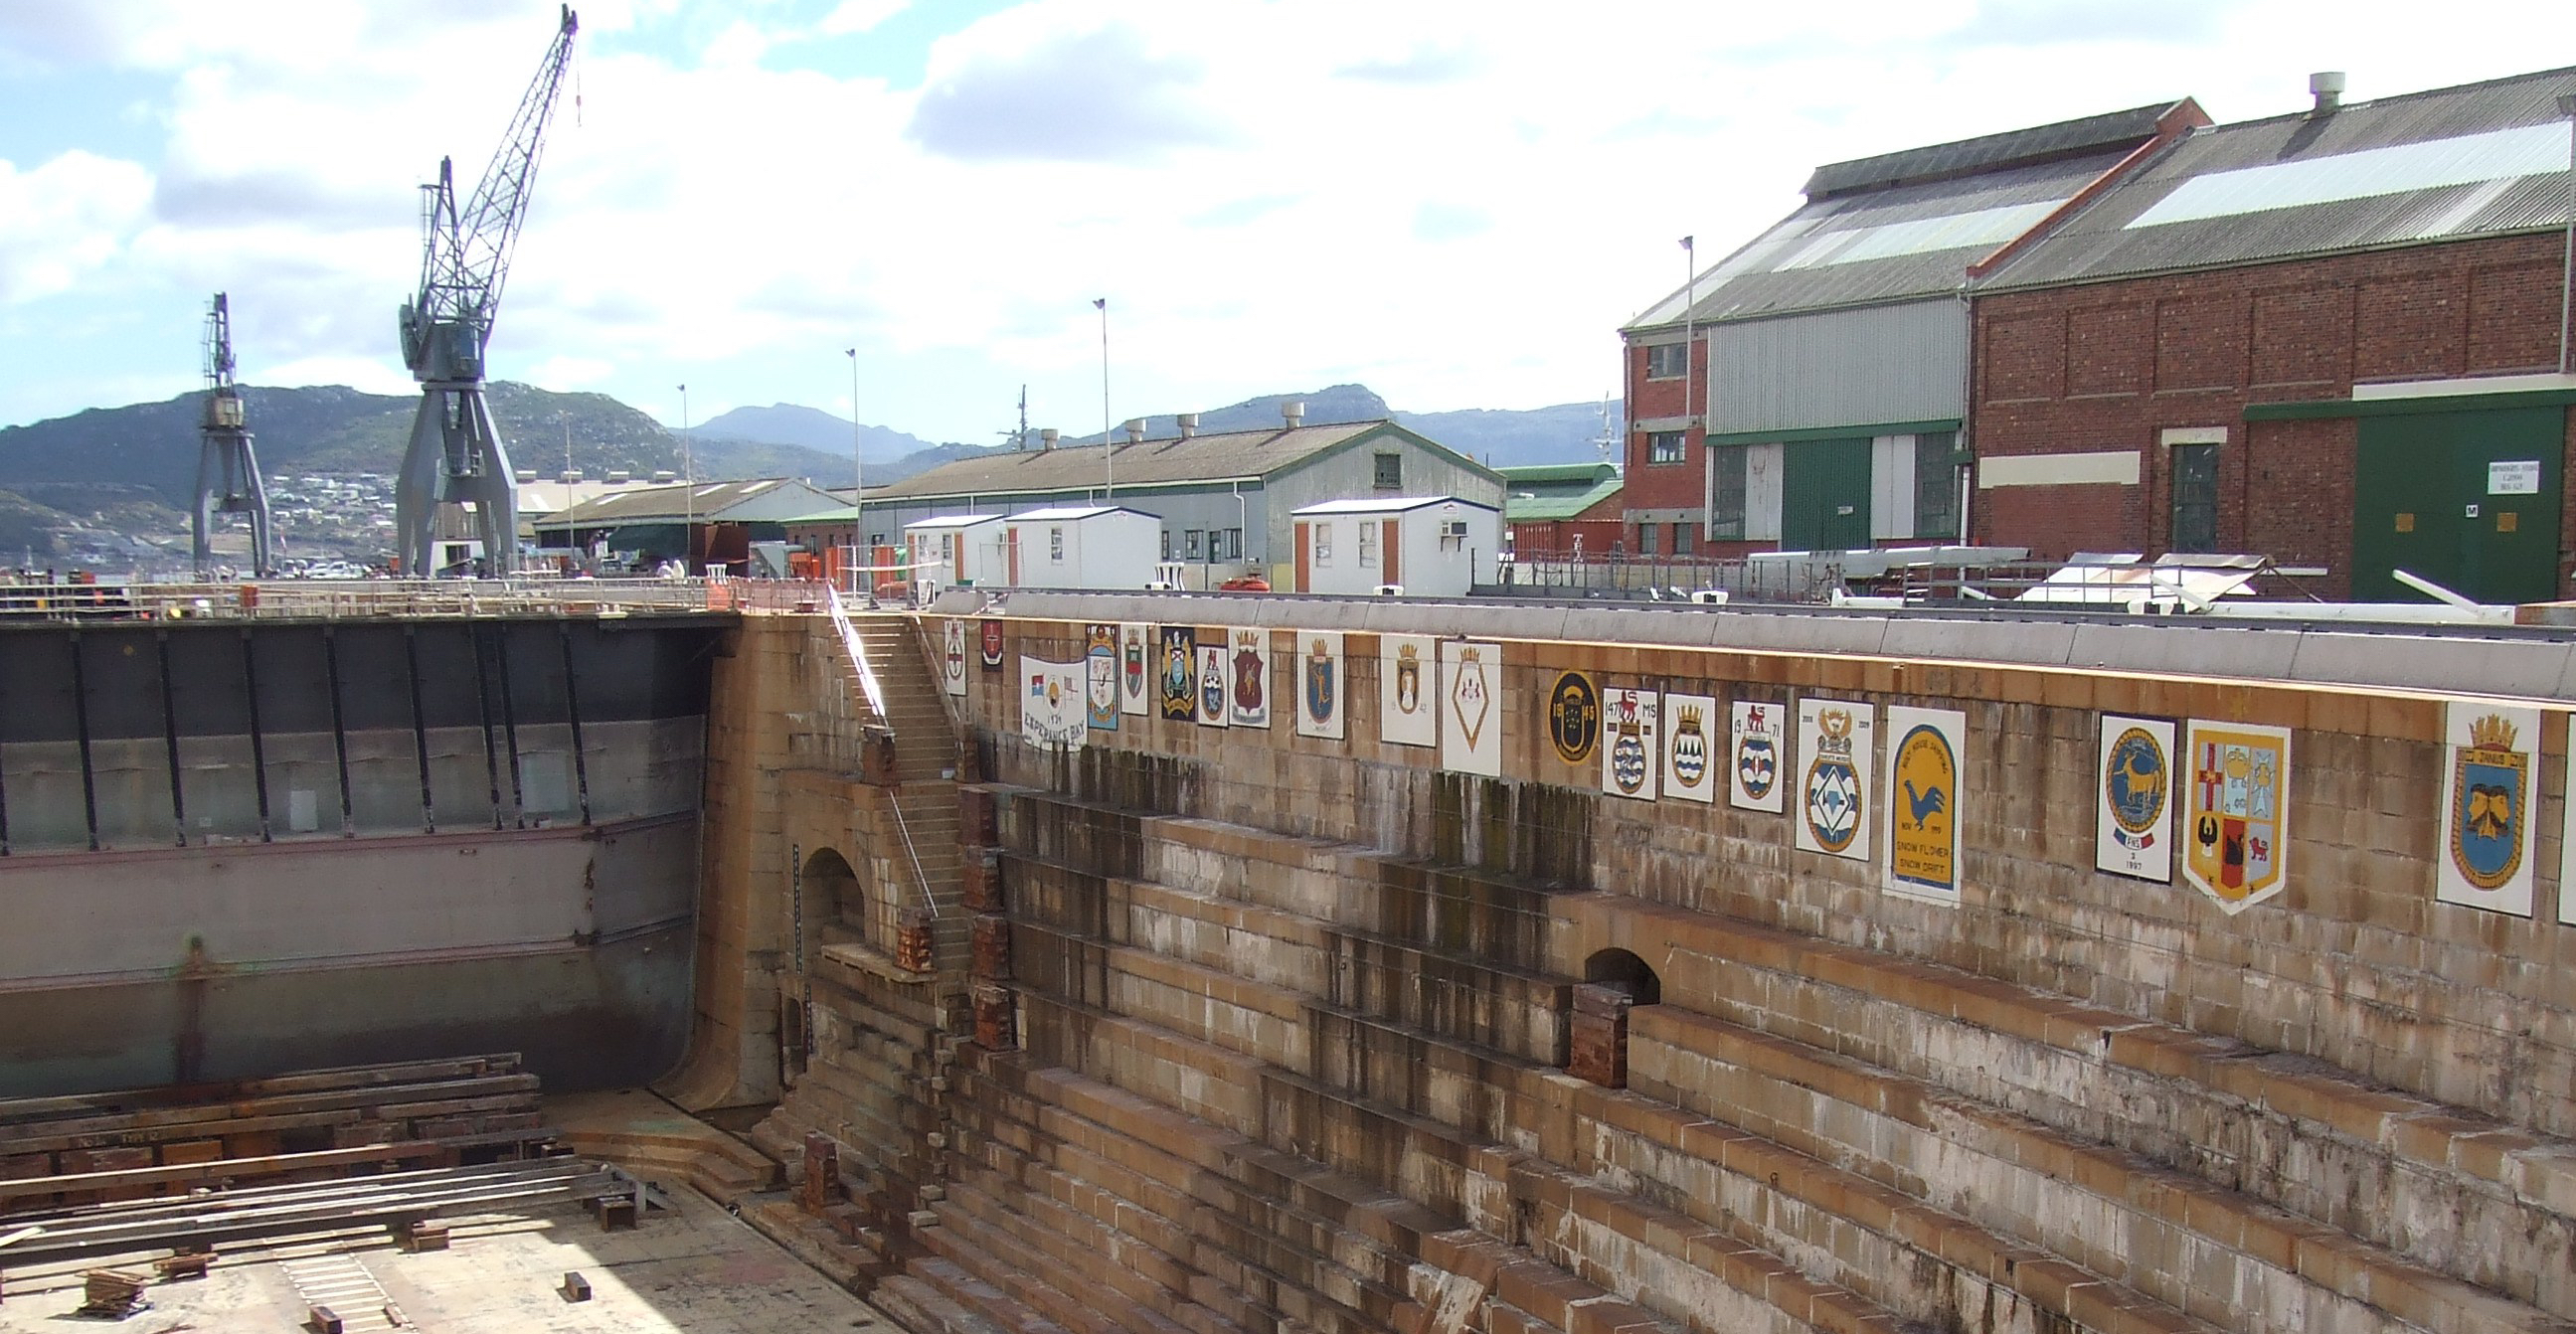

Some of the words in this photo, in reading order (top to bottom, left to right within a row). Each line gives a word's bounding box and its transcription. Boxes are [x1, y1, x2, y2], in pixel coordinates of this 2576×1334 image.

[2468, 506, 2477, 515] M
[1642, 703, 1656, 718] MS
[1773, 724, 1780, 738] 71
[1897, 840, 1918, 853] SNOW
[1900, 858, 1921, 869] SNOW
[1923, 862, 1946, 874] DRIFT
